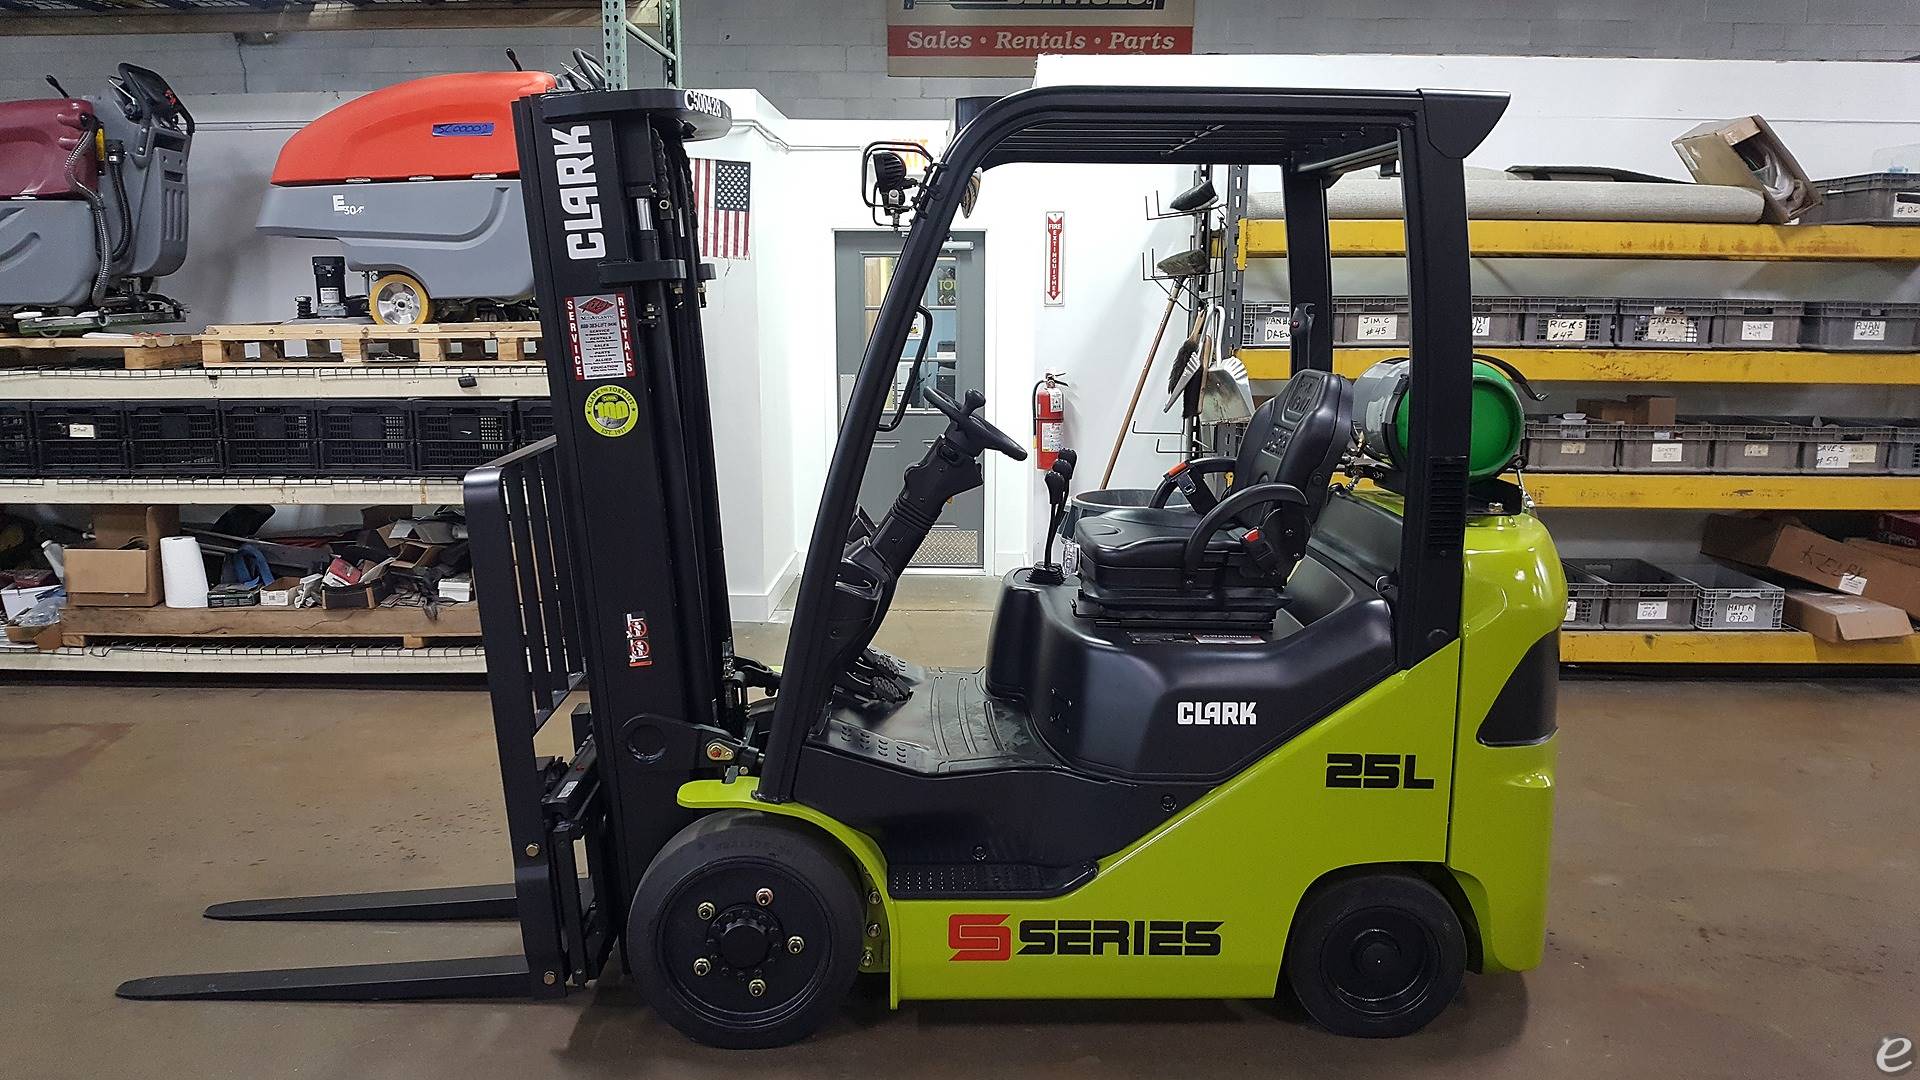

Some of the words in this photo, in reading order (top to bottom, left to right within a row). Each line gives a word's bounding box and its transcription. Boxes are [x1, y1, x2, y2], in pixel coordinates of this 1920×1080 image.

[907, 31, 972, 49] Sales
[995, 31, 1086, 50] Rentals
[1108, 32, 1175, 50] Parts
[684, 89, 721, 118] C500428
[551, 125, 606, 260] CLARK
[566, 300, 583, 376] SERVICE
[617, 297, 633, 372] RENTALS
[1855, 321, 1880, 330] RYAN
[1177, 701, 1257, 725] CLARK
[1325, 753, 1435, 789] 25L
[948, 914, 1011, 961] S
[1016, 919, 1224, 956] SERIES
